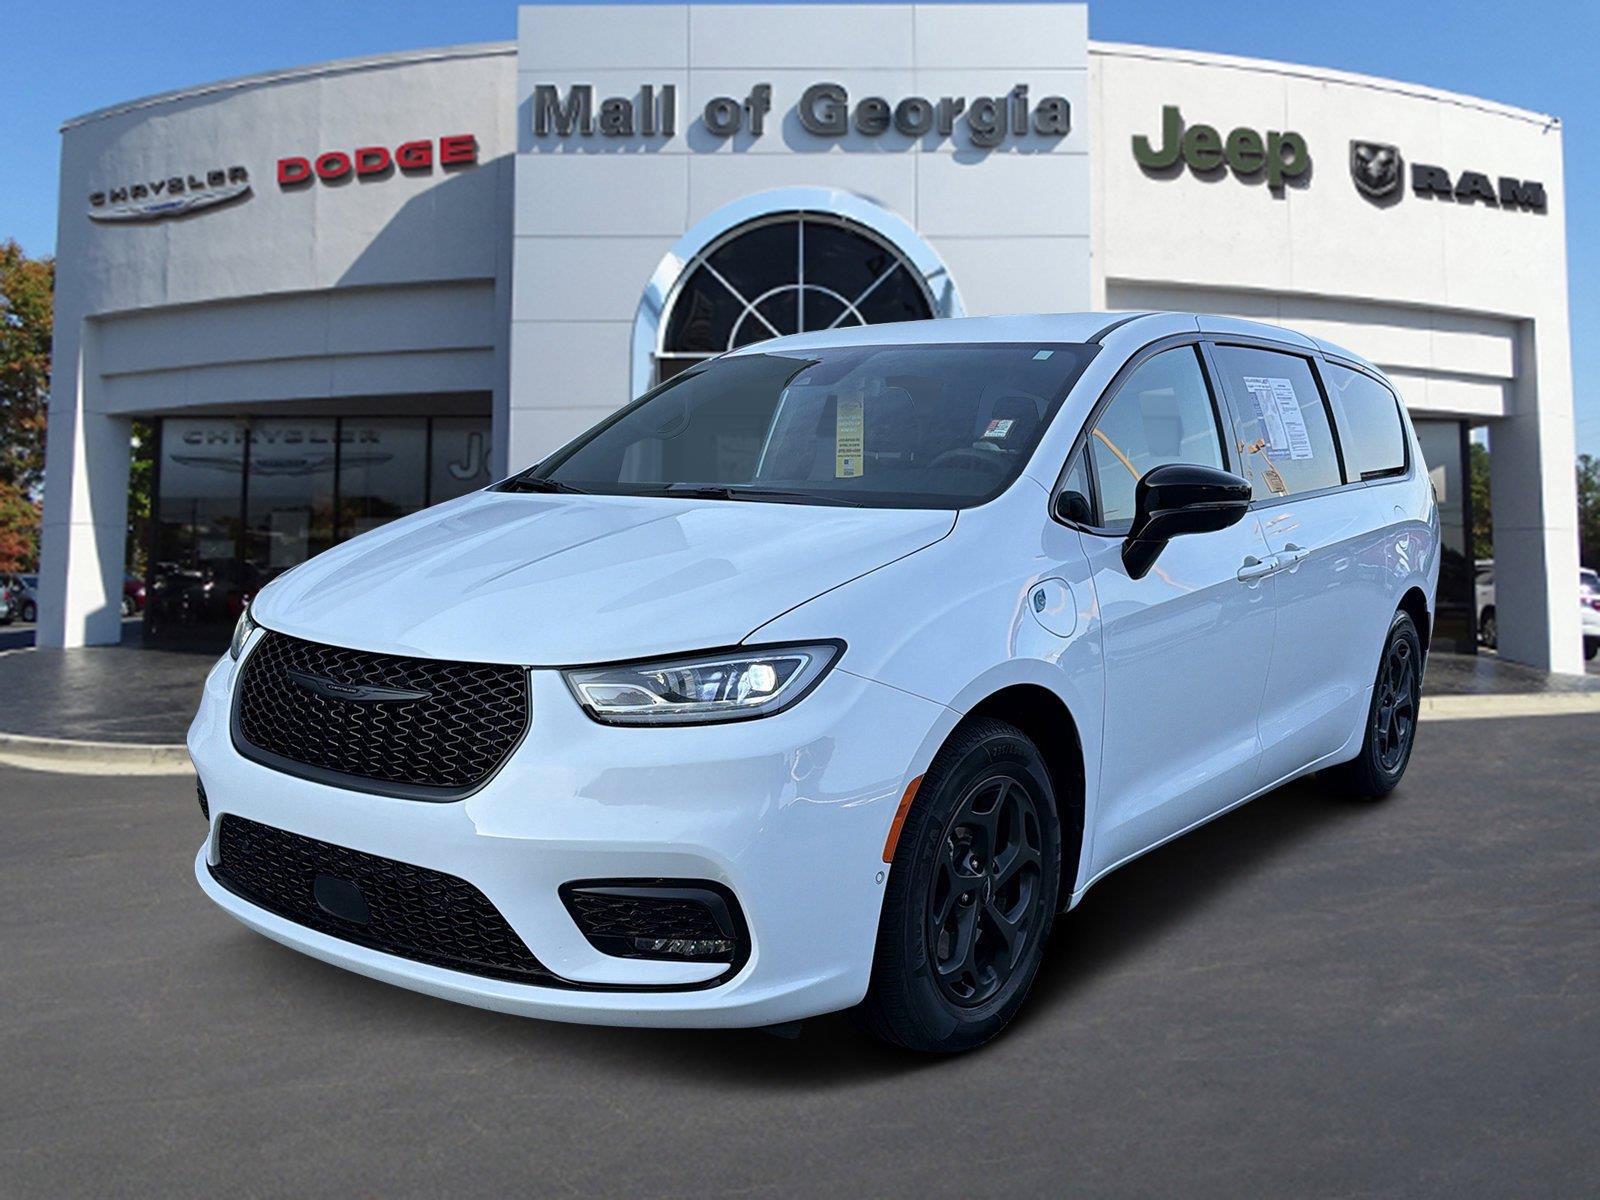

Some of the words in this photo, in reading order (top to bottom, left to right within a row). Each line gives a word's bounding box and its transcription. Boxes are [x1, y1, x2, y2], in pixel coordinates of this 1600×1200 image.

[533, 84, 676, 137] Mall
[703, 83, 772, 137] of
[799, 83, 1073, 148] Georgia
[277, 134, 478, 191] DODGE
[1132, 105, 1310, 195] Jeep
[89, 166, 249, 207] CHRYSLER
[1411, 162, 1547, 214] RAM
